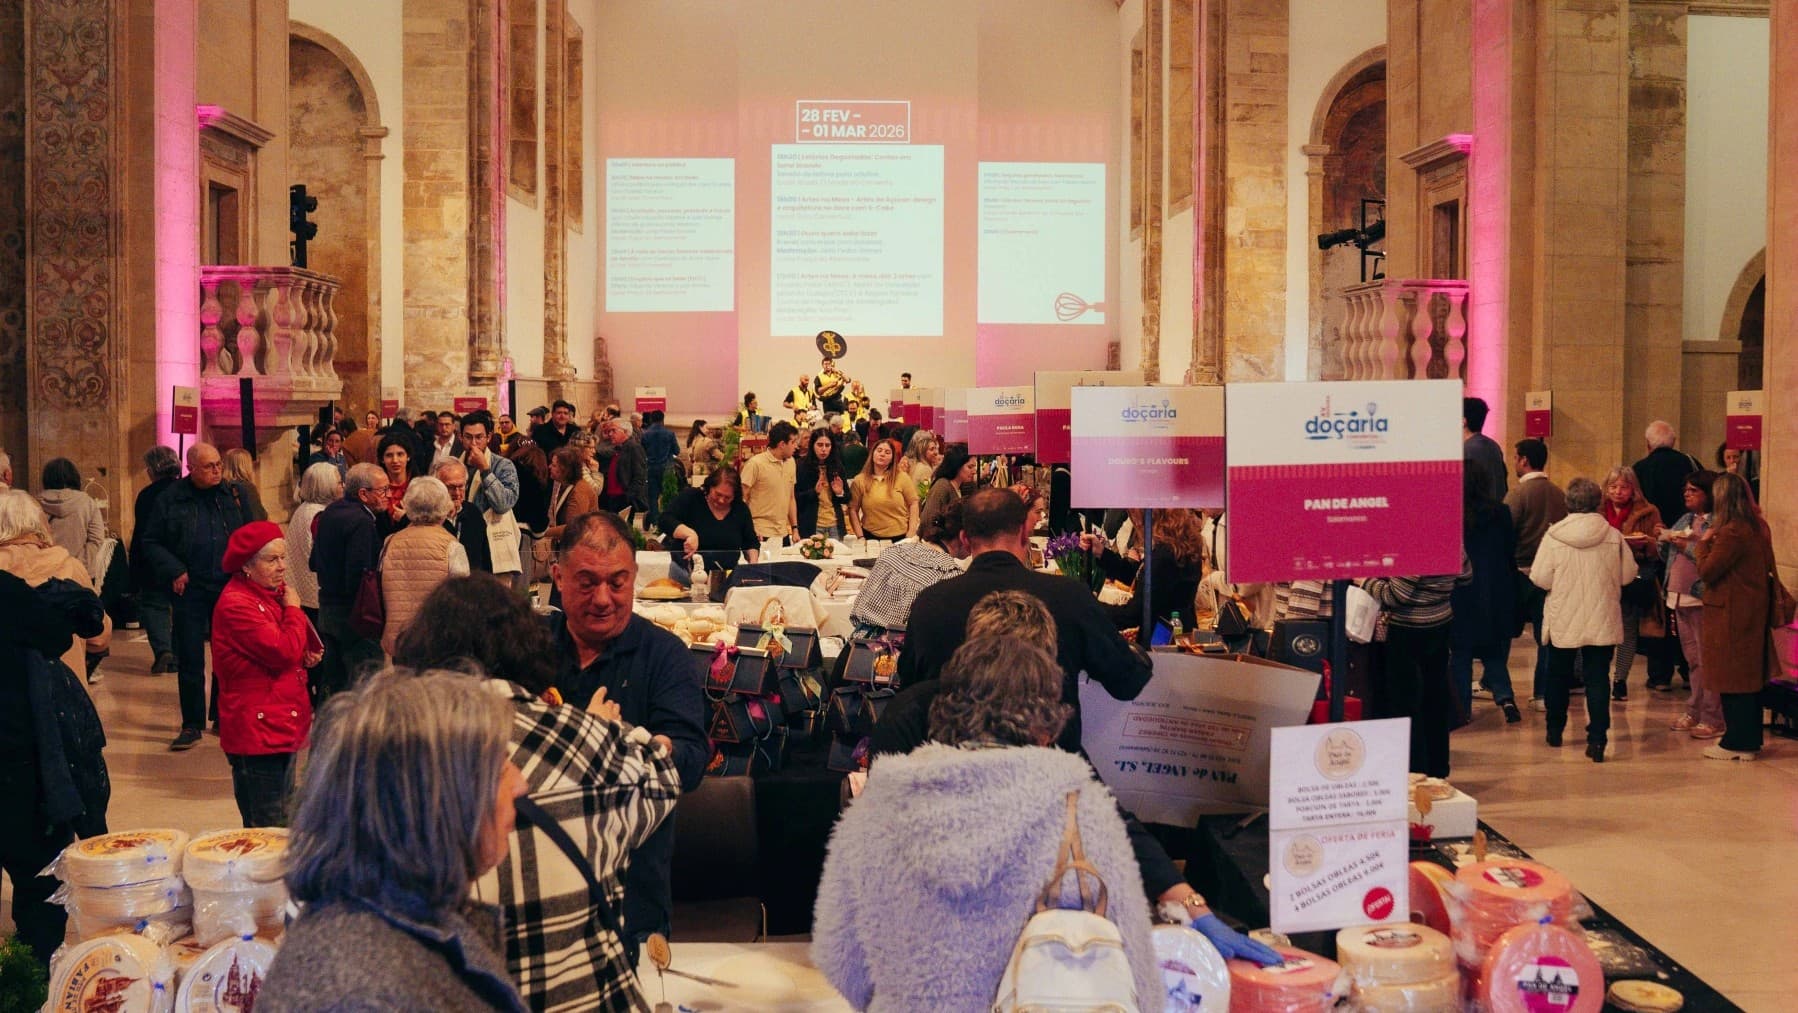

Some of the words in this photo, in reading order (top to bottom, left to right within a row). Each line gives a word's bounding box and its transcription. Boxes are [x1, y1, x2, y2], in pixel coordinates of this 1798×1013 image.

[801, 109, 820, 122] 28
[823, 109, 850, 122] FEV
[813, 124, 829, 137] 01
[831, 124, 867, 137] MAR
[869, 124, 905, 138] 2026
[1146, 457, 1189, 465] FLAVOURS
[1303, 498, 1331, 511] PAN
[1331, 497, 1348, 510] DE
[1349, 496, 1390, 509] ANGEL
[1321, 834, 1356, 844] OFERTA
[1357, 832, 1368, 841] DE
[1370, 830, 1396, 839] FERIA
[1295, 877, 1327, 897] BOLSAS
[1328, 861, 1359, 881] OBLEAS
[1300, 888, 1331, 909] BOLSAS
[1332, 873, 1363, 893] OBLEAS
